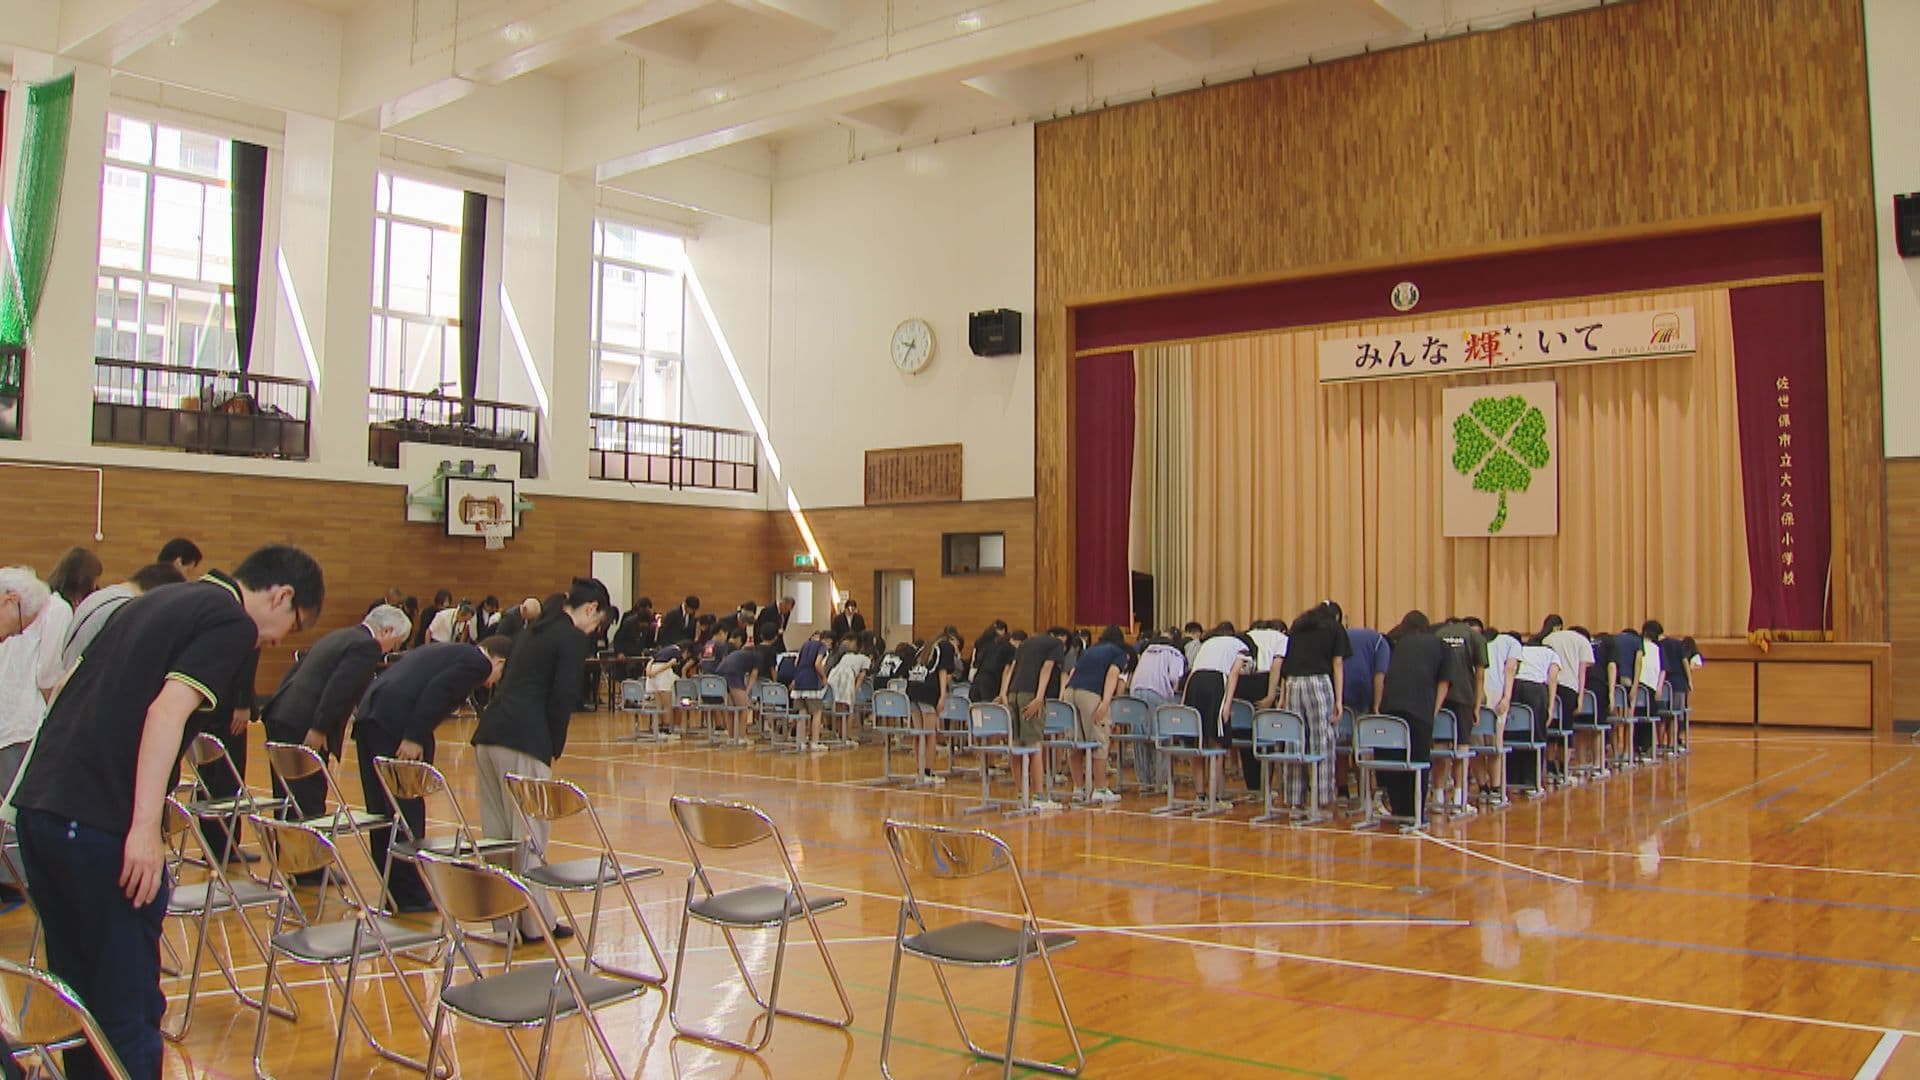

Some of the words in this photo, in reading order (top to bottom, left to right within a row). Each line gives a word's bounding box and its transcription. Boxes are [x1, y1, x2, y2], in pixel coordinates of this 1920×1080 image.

[1775, 375, 1795, 586] 佐世保市立大久保小学校
